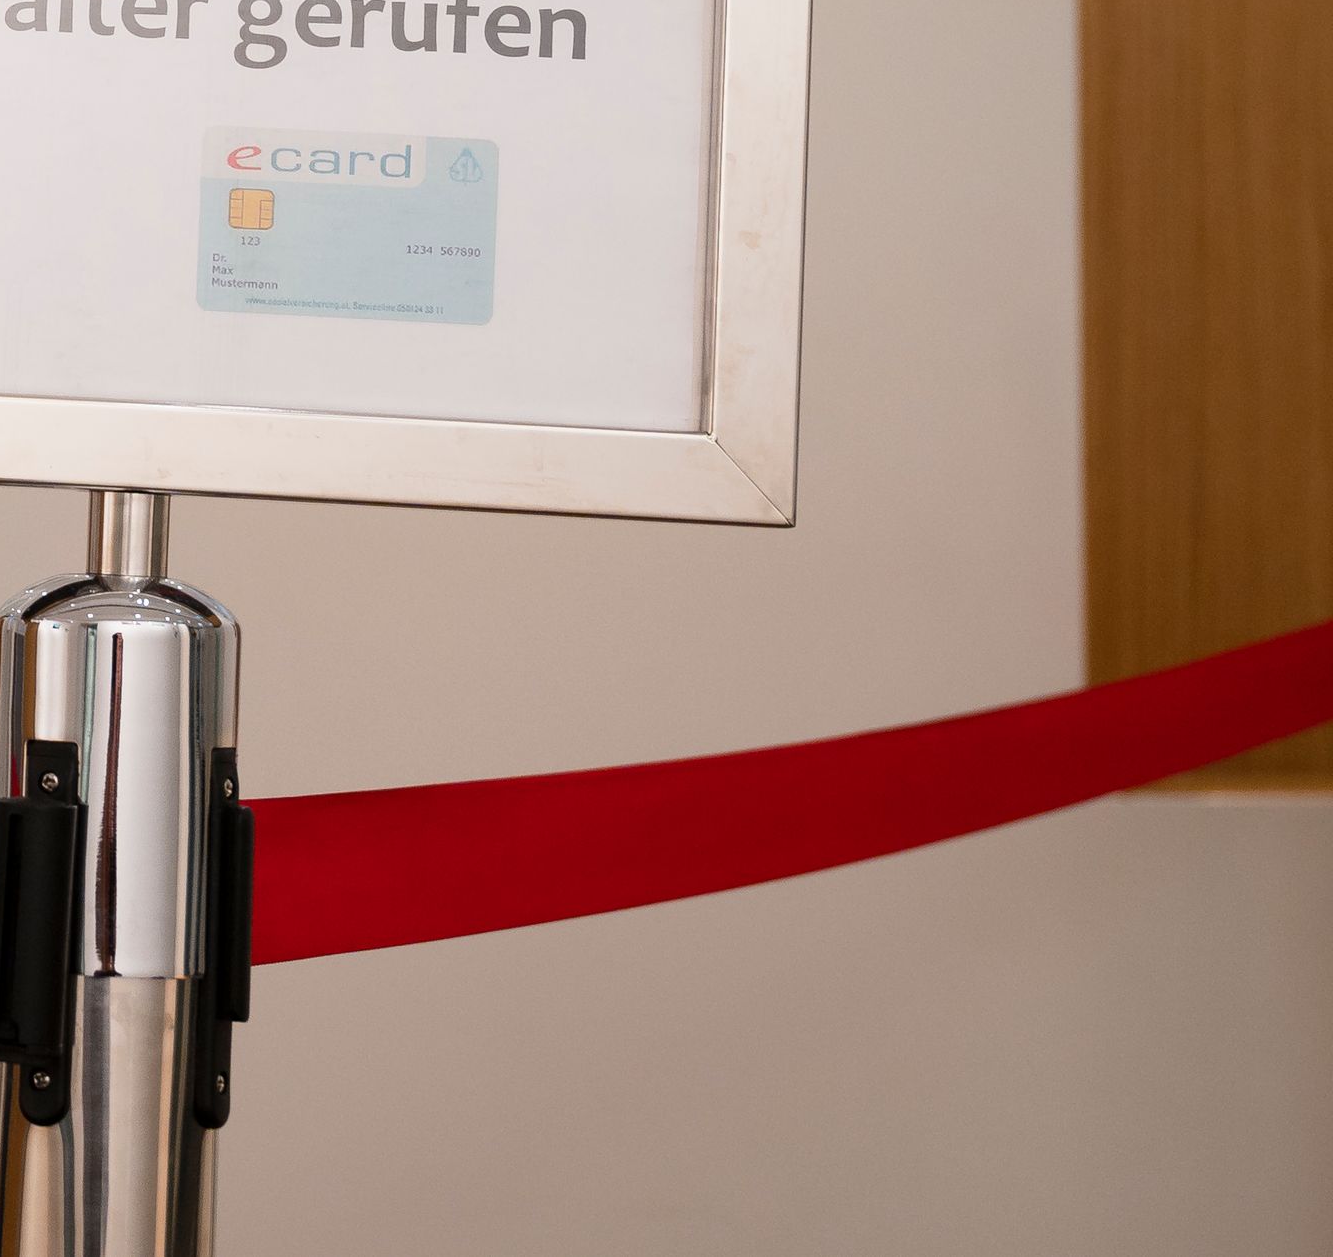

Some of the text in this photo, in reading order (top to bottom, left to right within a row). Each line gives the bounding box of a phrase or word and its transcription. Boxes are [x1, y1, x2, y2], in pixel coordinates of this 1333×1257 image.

[226, 144, 413, 180] ecard
[240, 235, 262, 247] 123
[406, 244, 482, 258] 1234 567890
[212, 253, 228, 263] Dr.
[212, 265, 234, 276] Max
[211, 277, 279, 290] Mustermann
